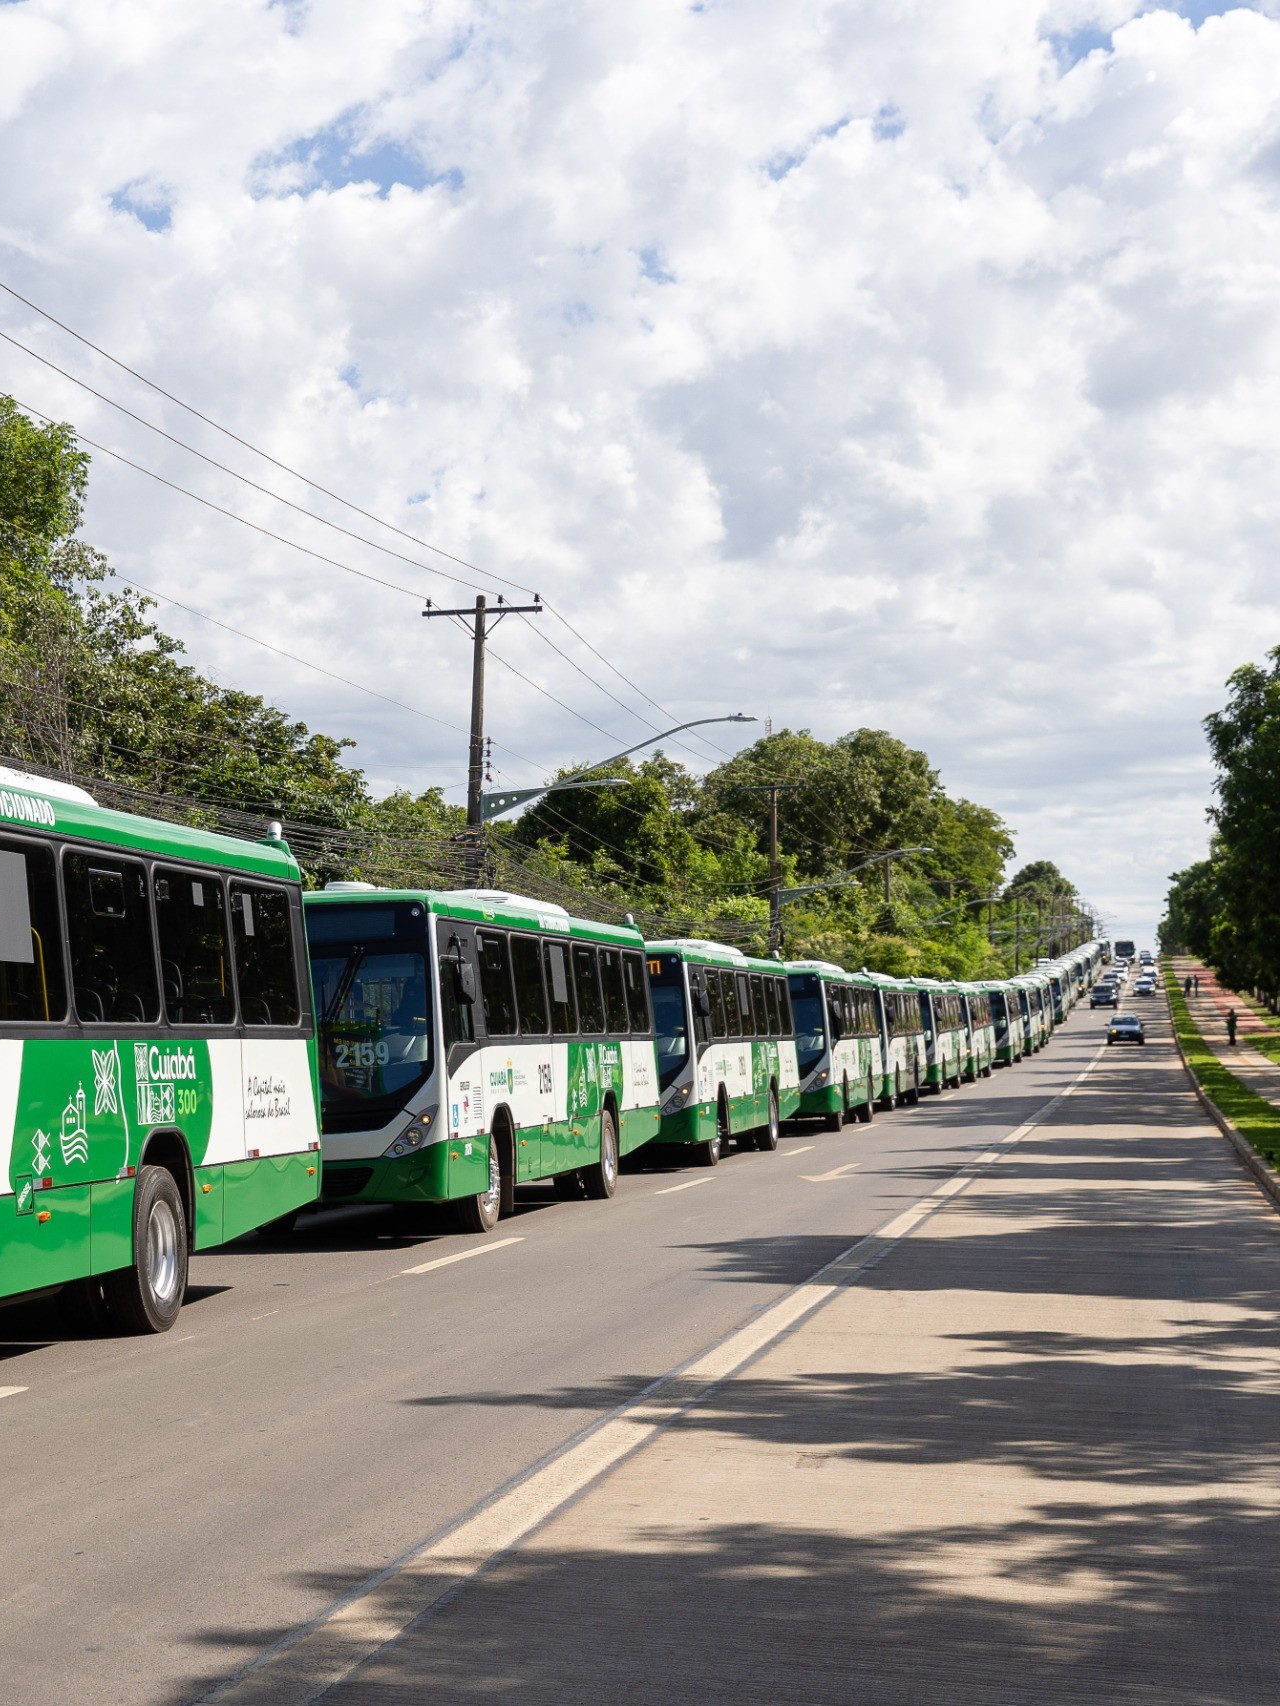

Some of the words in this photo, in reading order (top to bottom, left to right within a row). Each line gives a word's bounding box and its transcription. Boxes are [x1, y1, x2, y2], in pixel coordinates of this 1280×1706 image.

[149, 1046, 196, 1080] Cuiabá
[335, 1042, 389, 1067] 2159
[178, 1089, 197, 1114] 300
